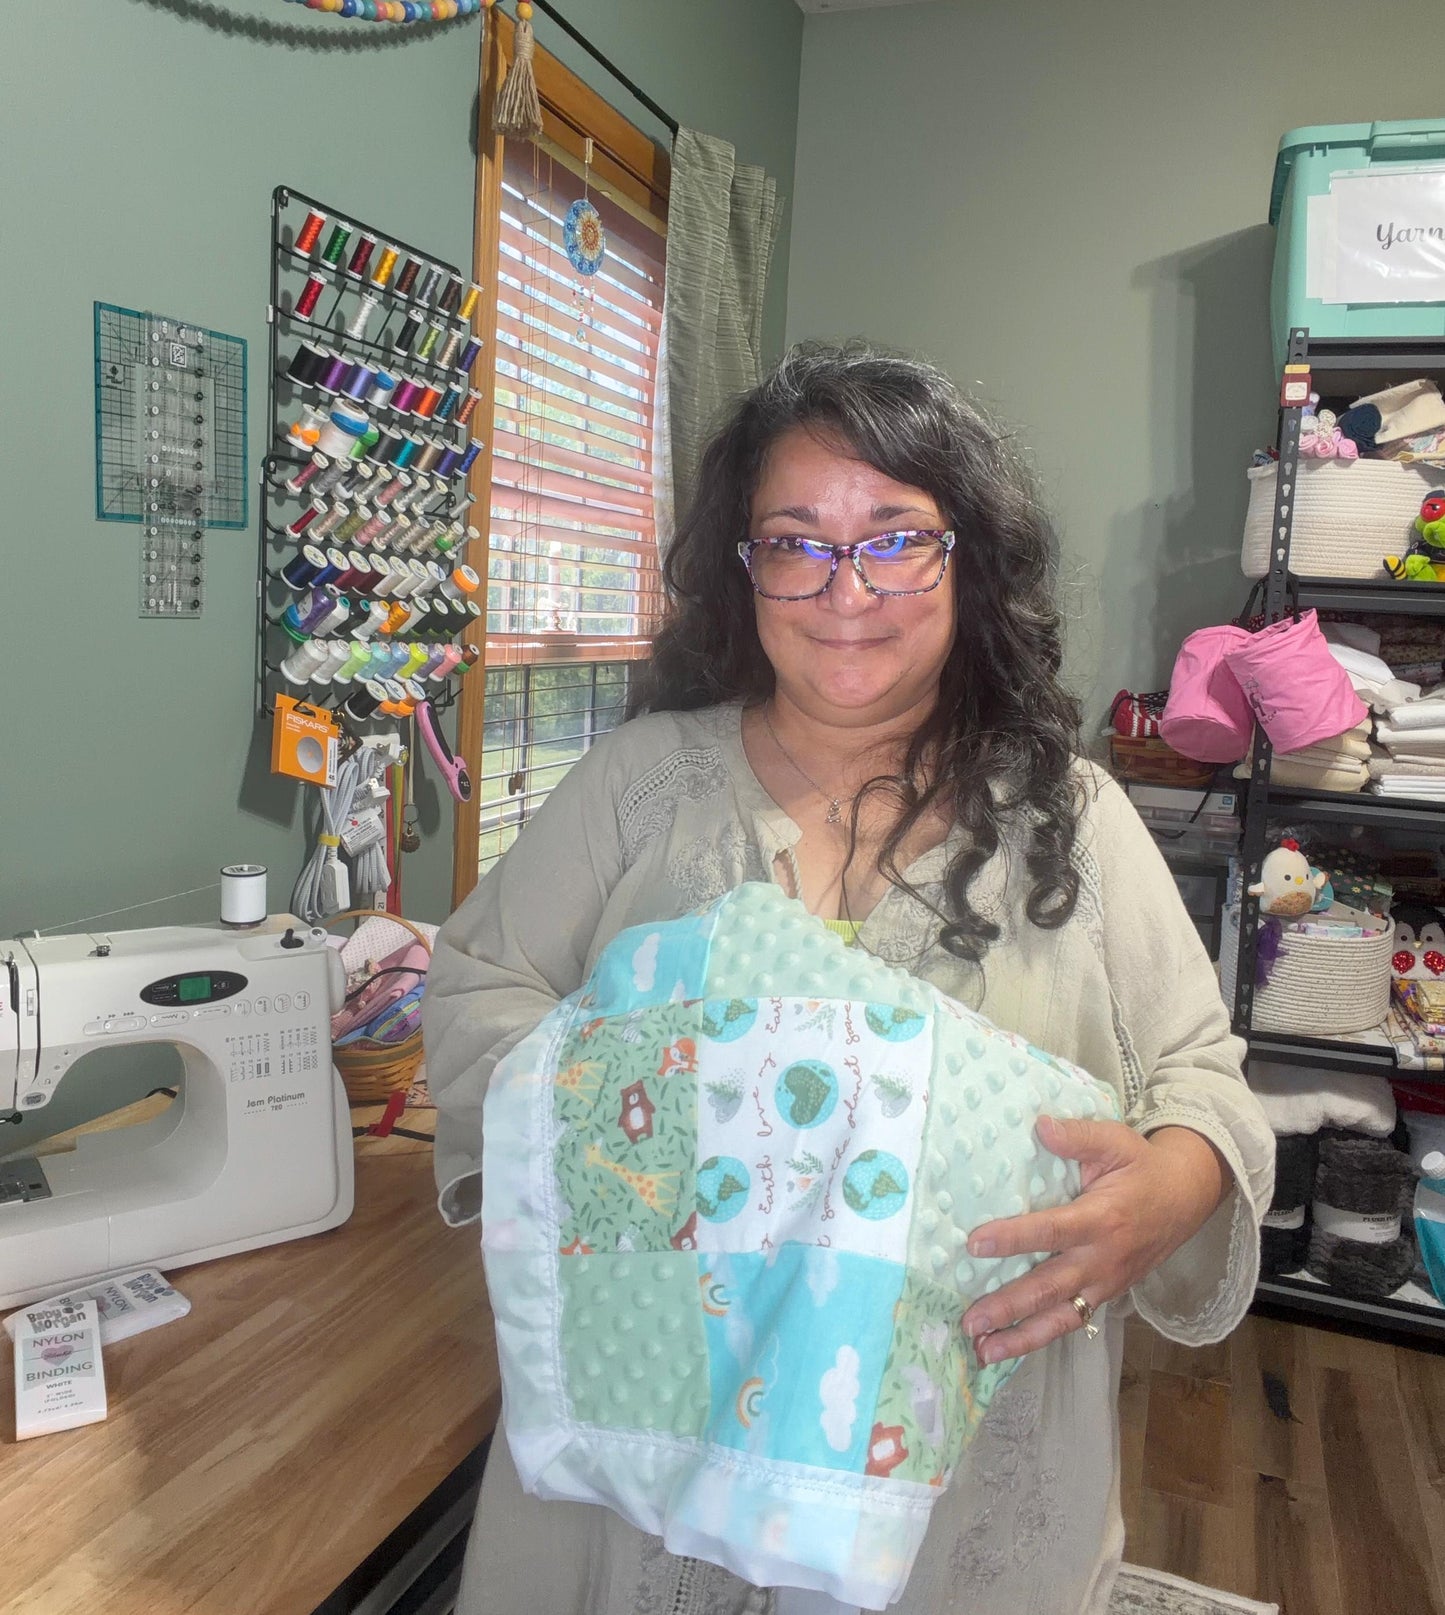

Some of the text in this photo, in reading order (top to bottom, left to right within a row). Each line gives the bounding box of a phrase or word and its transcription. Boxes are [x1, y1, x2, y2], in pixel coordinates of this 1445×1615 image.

[1376, 222, 1445, 250] Yarn
[286, 713, 330, 734] FISKARS
[246, 1091, 305, 1108] Jem Platinum
[843, 1055, 863, 1129] planet
[753, 1086, 773, 1137] love
[756, 1155, 775, 1215] Earth
[105, 1286, 131, 1312] NYLON
[26, 1308, 62, 1323] Baby
[31, 1311, 87, 1334] Morgan
[32, 1331, 85, 1348] NYLON
[26, 1361, 93, 1382] BINDING
